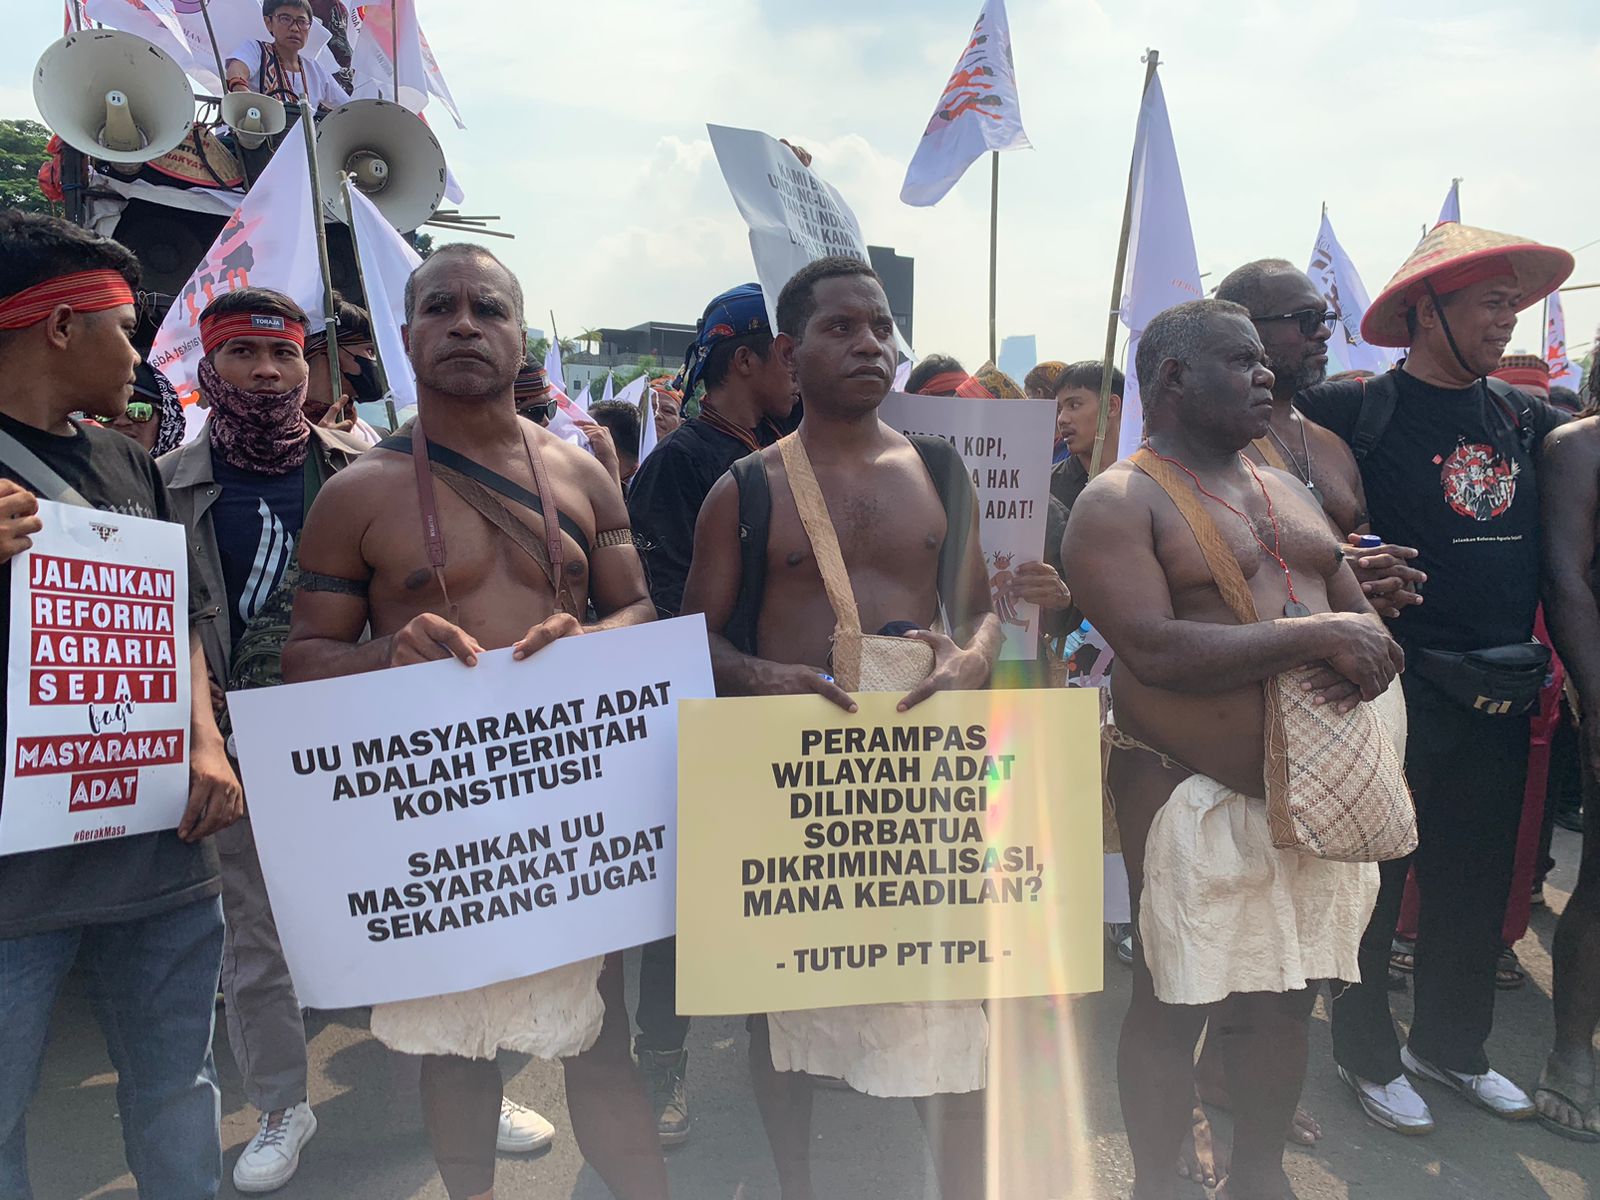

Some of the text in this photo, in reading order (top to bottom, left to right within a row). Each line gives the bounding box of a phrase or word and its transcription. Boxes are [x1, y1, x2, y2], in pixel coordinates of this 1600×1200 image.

[777, 161, 808, 188] KAMI
[767, 173, 841, 214] UNDANG-UN
[780, 192, 808, 220] YANG
[799, 219, 856, 248] HAK KAMI
[255, 318, 281, 326] TORAJA
[964, 436, 1007, 461] KOPI,
[987, 468, 1020, 489] HAK
[985, 500, 1034, 519] ADAT!
[32, 558, 172, 598] JALANKAN
[35, 597, 172, 632] REFORMA
[35, 634, 173, 665] AGRARIA
[38, 673, 171, 701] SEJATI
[88, 694, 136, 734] bagi
[291, 680, 671, 775] UU MASYARAKAT ADAT
[18, 735, 178, 769] MASYARAKAT
[801, 724, 987, 756] PERAMPAS
[332, 715, 648, 801] ADALAH PERINTAH
[771, 754, 1015, 789] WILAYAH ADAT
[71, 776, 136, 805] ADAT
[392, 754, 603, 821] KONSTITUSI!
[73, 825, 126, 842] #GerakMasa
[407, 811, 605, 878] SAHKAN UU
[803, 817, 984, 850] SORBATUA
[347, 824, 667, 917] MASYARAKAT ADAT
[741, 846, 1045, 886] DIKRIMINALISASI,
[366, 856, 657, 943] SEKARANG JUGA!
[743, 876, 1044, 918] MANA KEADILAN?
[793, 943, 888, 973] TUTUP
[897, 941, 932, 966] PT
[940, 939, 994, 964] TPL
